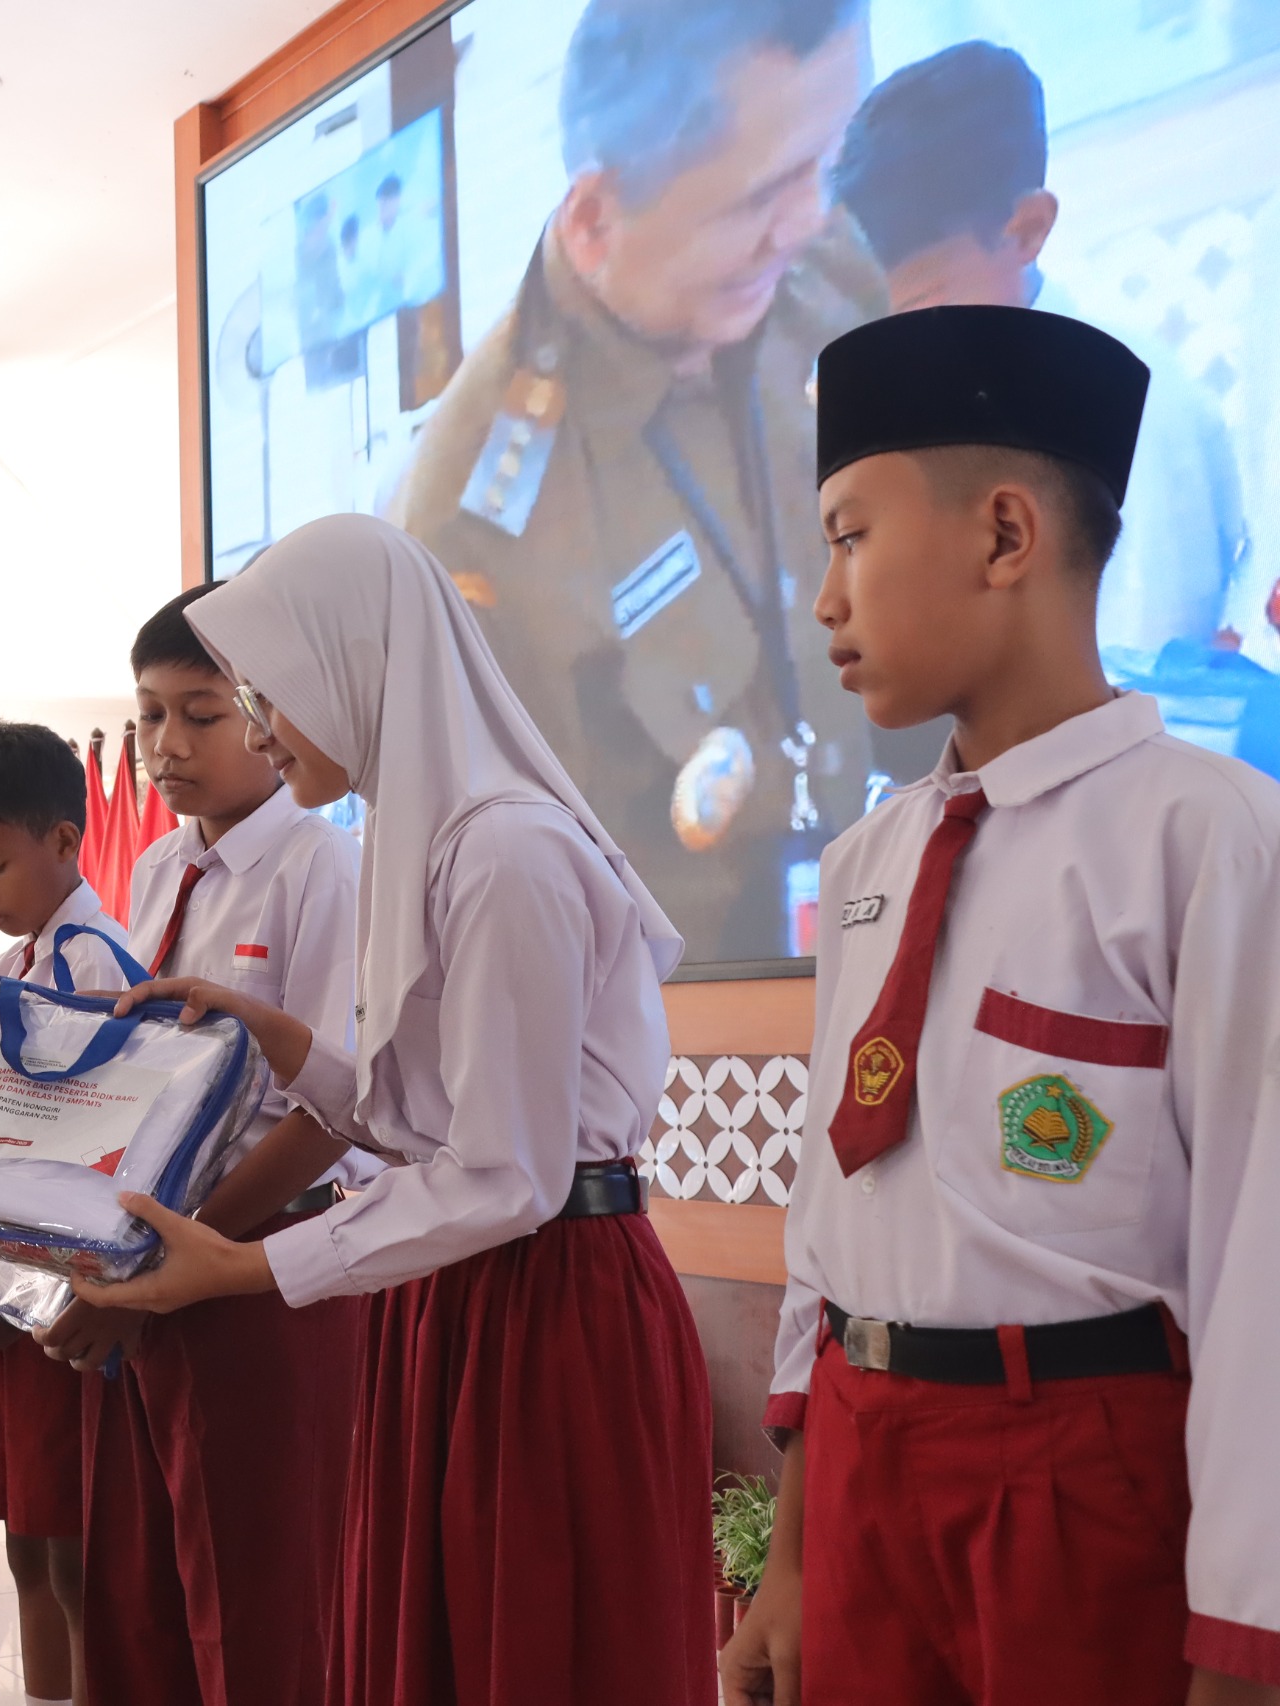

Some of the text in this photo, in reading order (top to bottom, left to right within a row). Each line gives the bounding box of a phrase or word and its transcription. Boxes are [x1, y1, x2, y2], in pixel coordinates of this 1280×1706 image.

[3, 1076, 31, 1087] GRATIS
[32, 1082, 53, 1091] BAGI
[54, 1085, 89, 1097] PESERTA
[91, 1091, 113, 1100] DIDIK
[6, 1086, 25, 1095] DAN
[26, 1091, 52, 1100] KELAS
[66, 1097, 102, 1108] SMP/MTs
[23, 1103, 61, 1113] WONOGIRI
[41, 1112, 58, 1121] 2025
